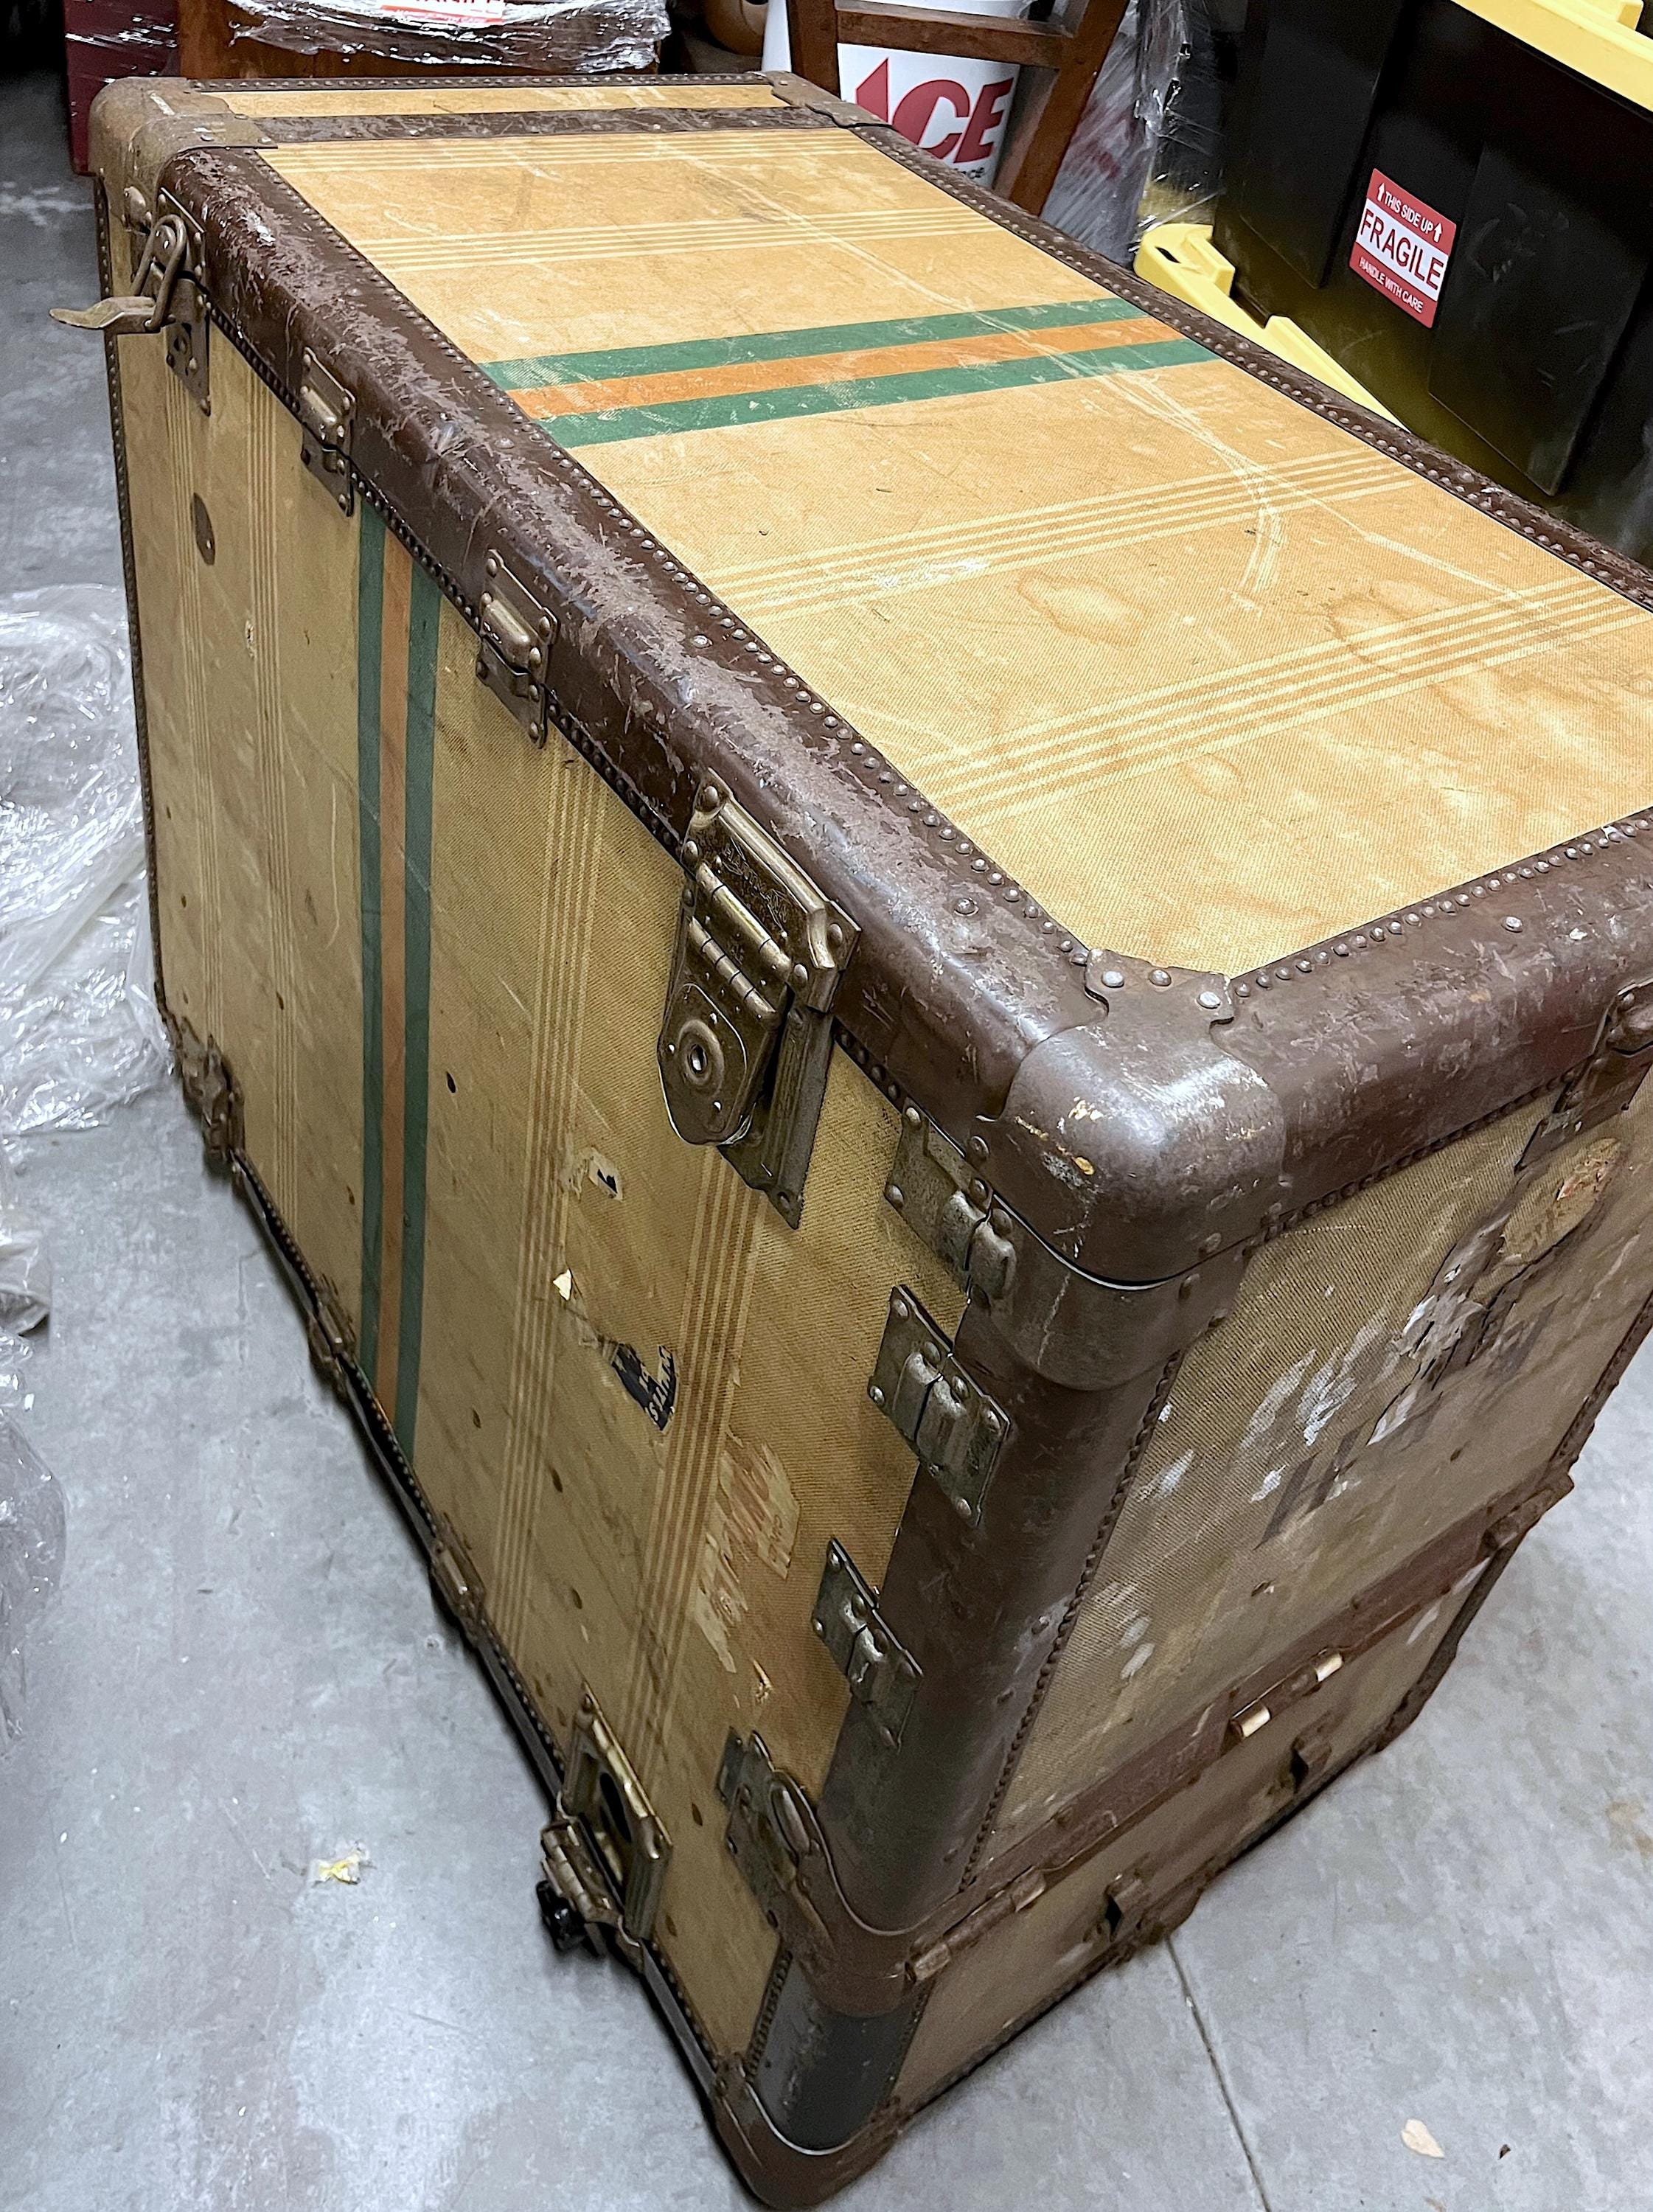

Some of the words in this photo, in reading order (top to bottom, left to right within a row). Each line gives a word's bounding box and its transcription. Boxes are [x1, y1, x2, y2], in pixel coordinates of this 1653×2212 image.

[855, 58, 1014, 164] ACE
[1385, 191, 1401, 214] THIS
[1401, 204, 1421, 228] SIDE
[1421, 218, 1434, 234] UP
[1360, 209, 1444, 290] FRAGILE
[1360, 257, 1385, 285] HANDLE
[1385, 277, 1402, 298] WITH
[1402, 291, 1424, 313] CARE
